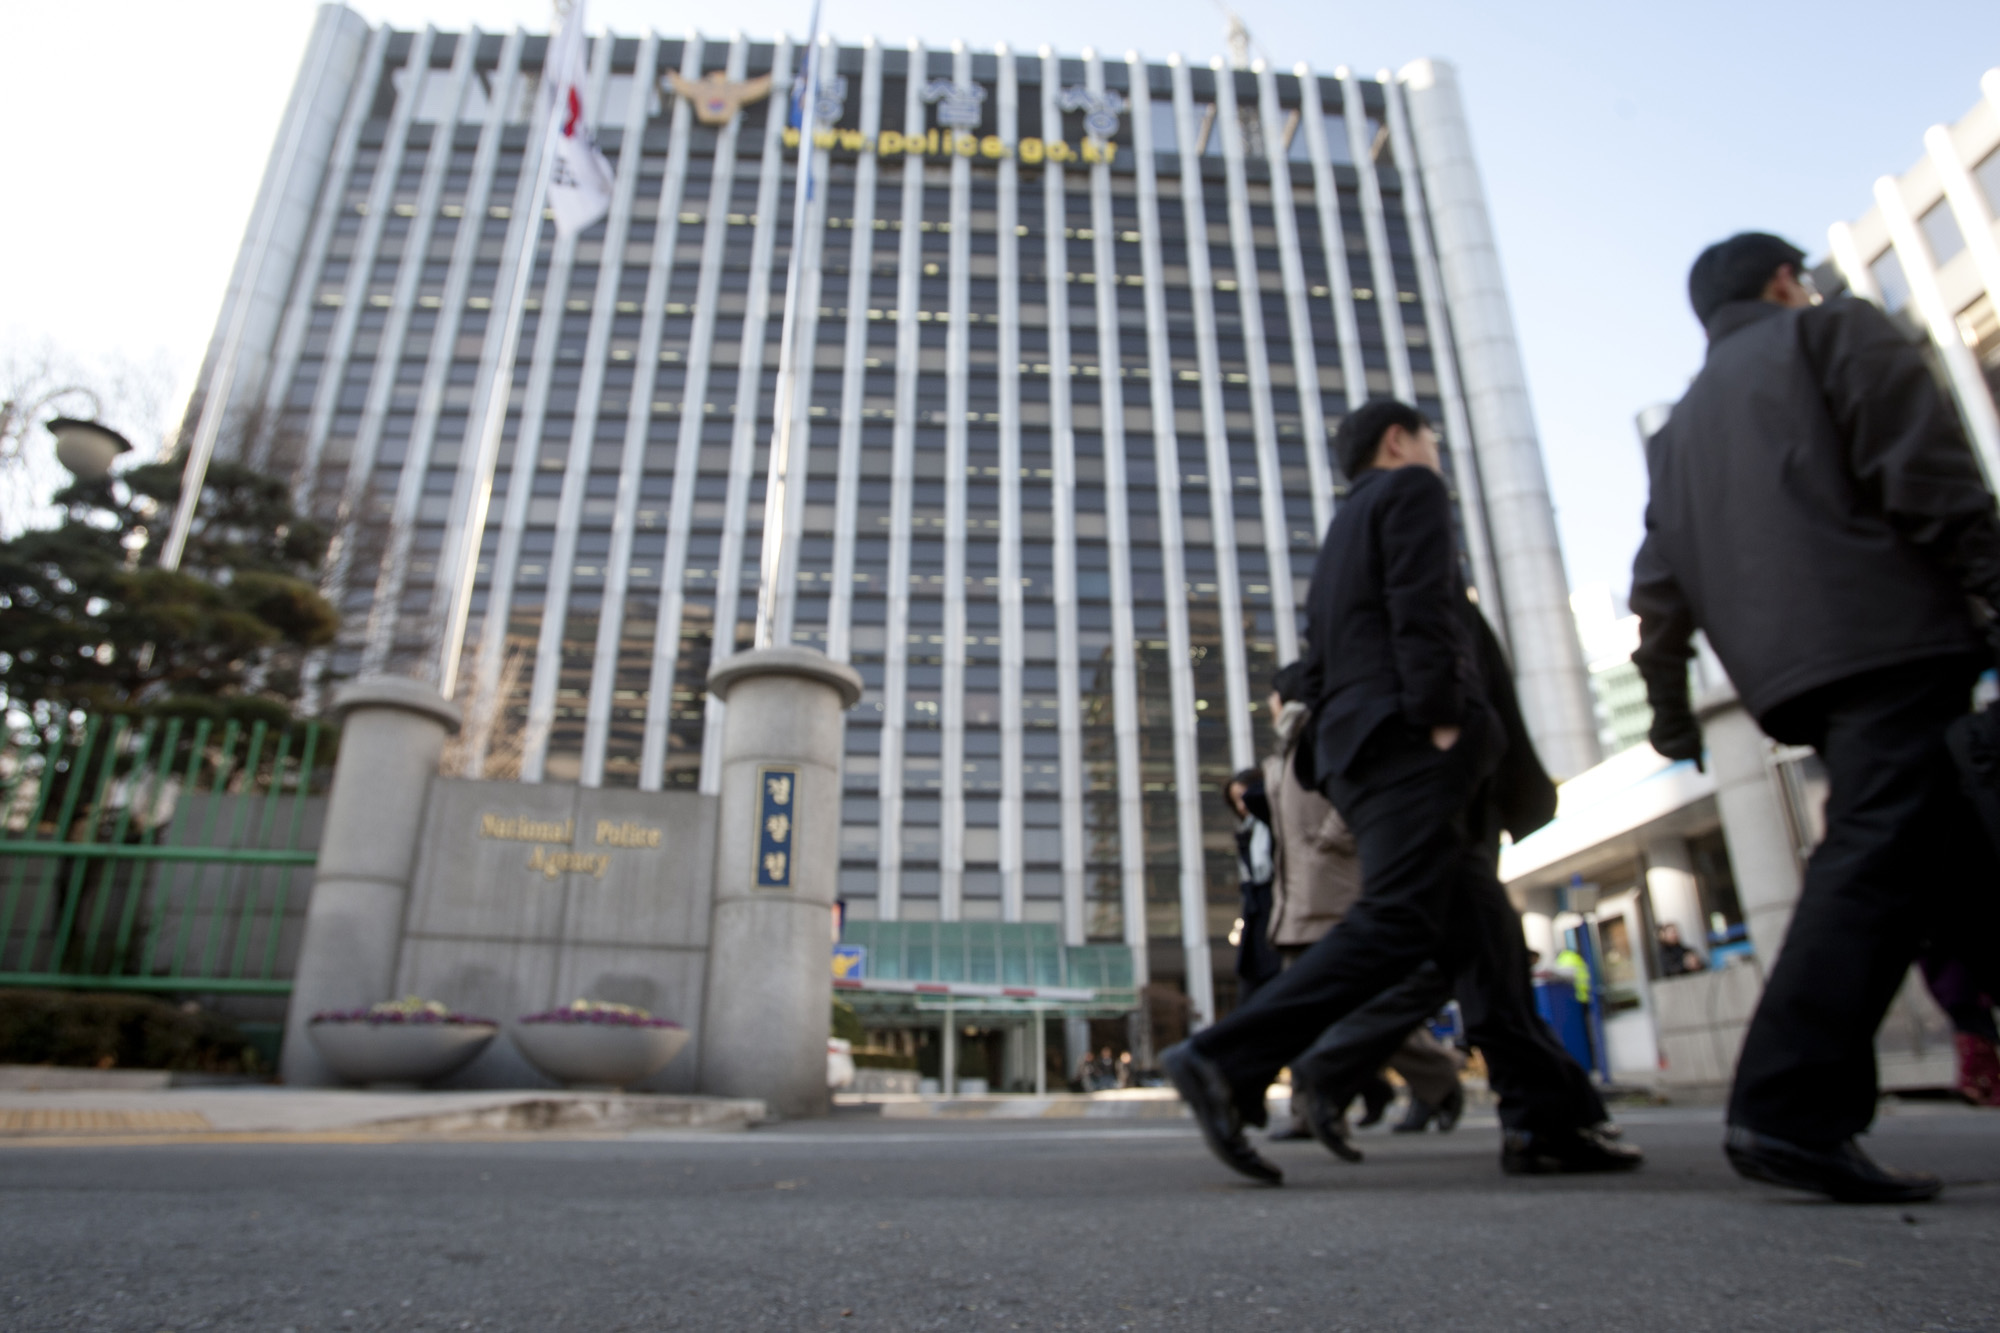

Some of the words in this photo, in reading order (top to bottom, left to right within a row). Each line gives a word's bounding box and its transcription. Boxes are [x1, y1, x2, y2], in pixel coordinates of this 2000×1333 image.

[781, 126, 1118, 164] www.police.go.kr
[480, 813, 574, 846] National
[595, 820, 663, 848] Police
[527, 846, 611, 880] Agency
